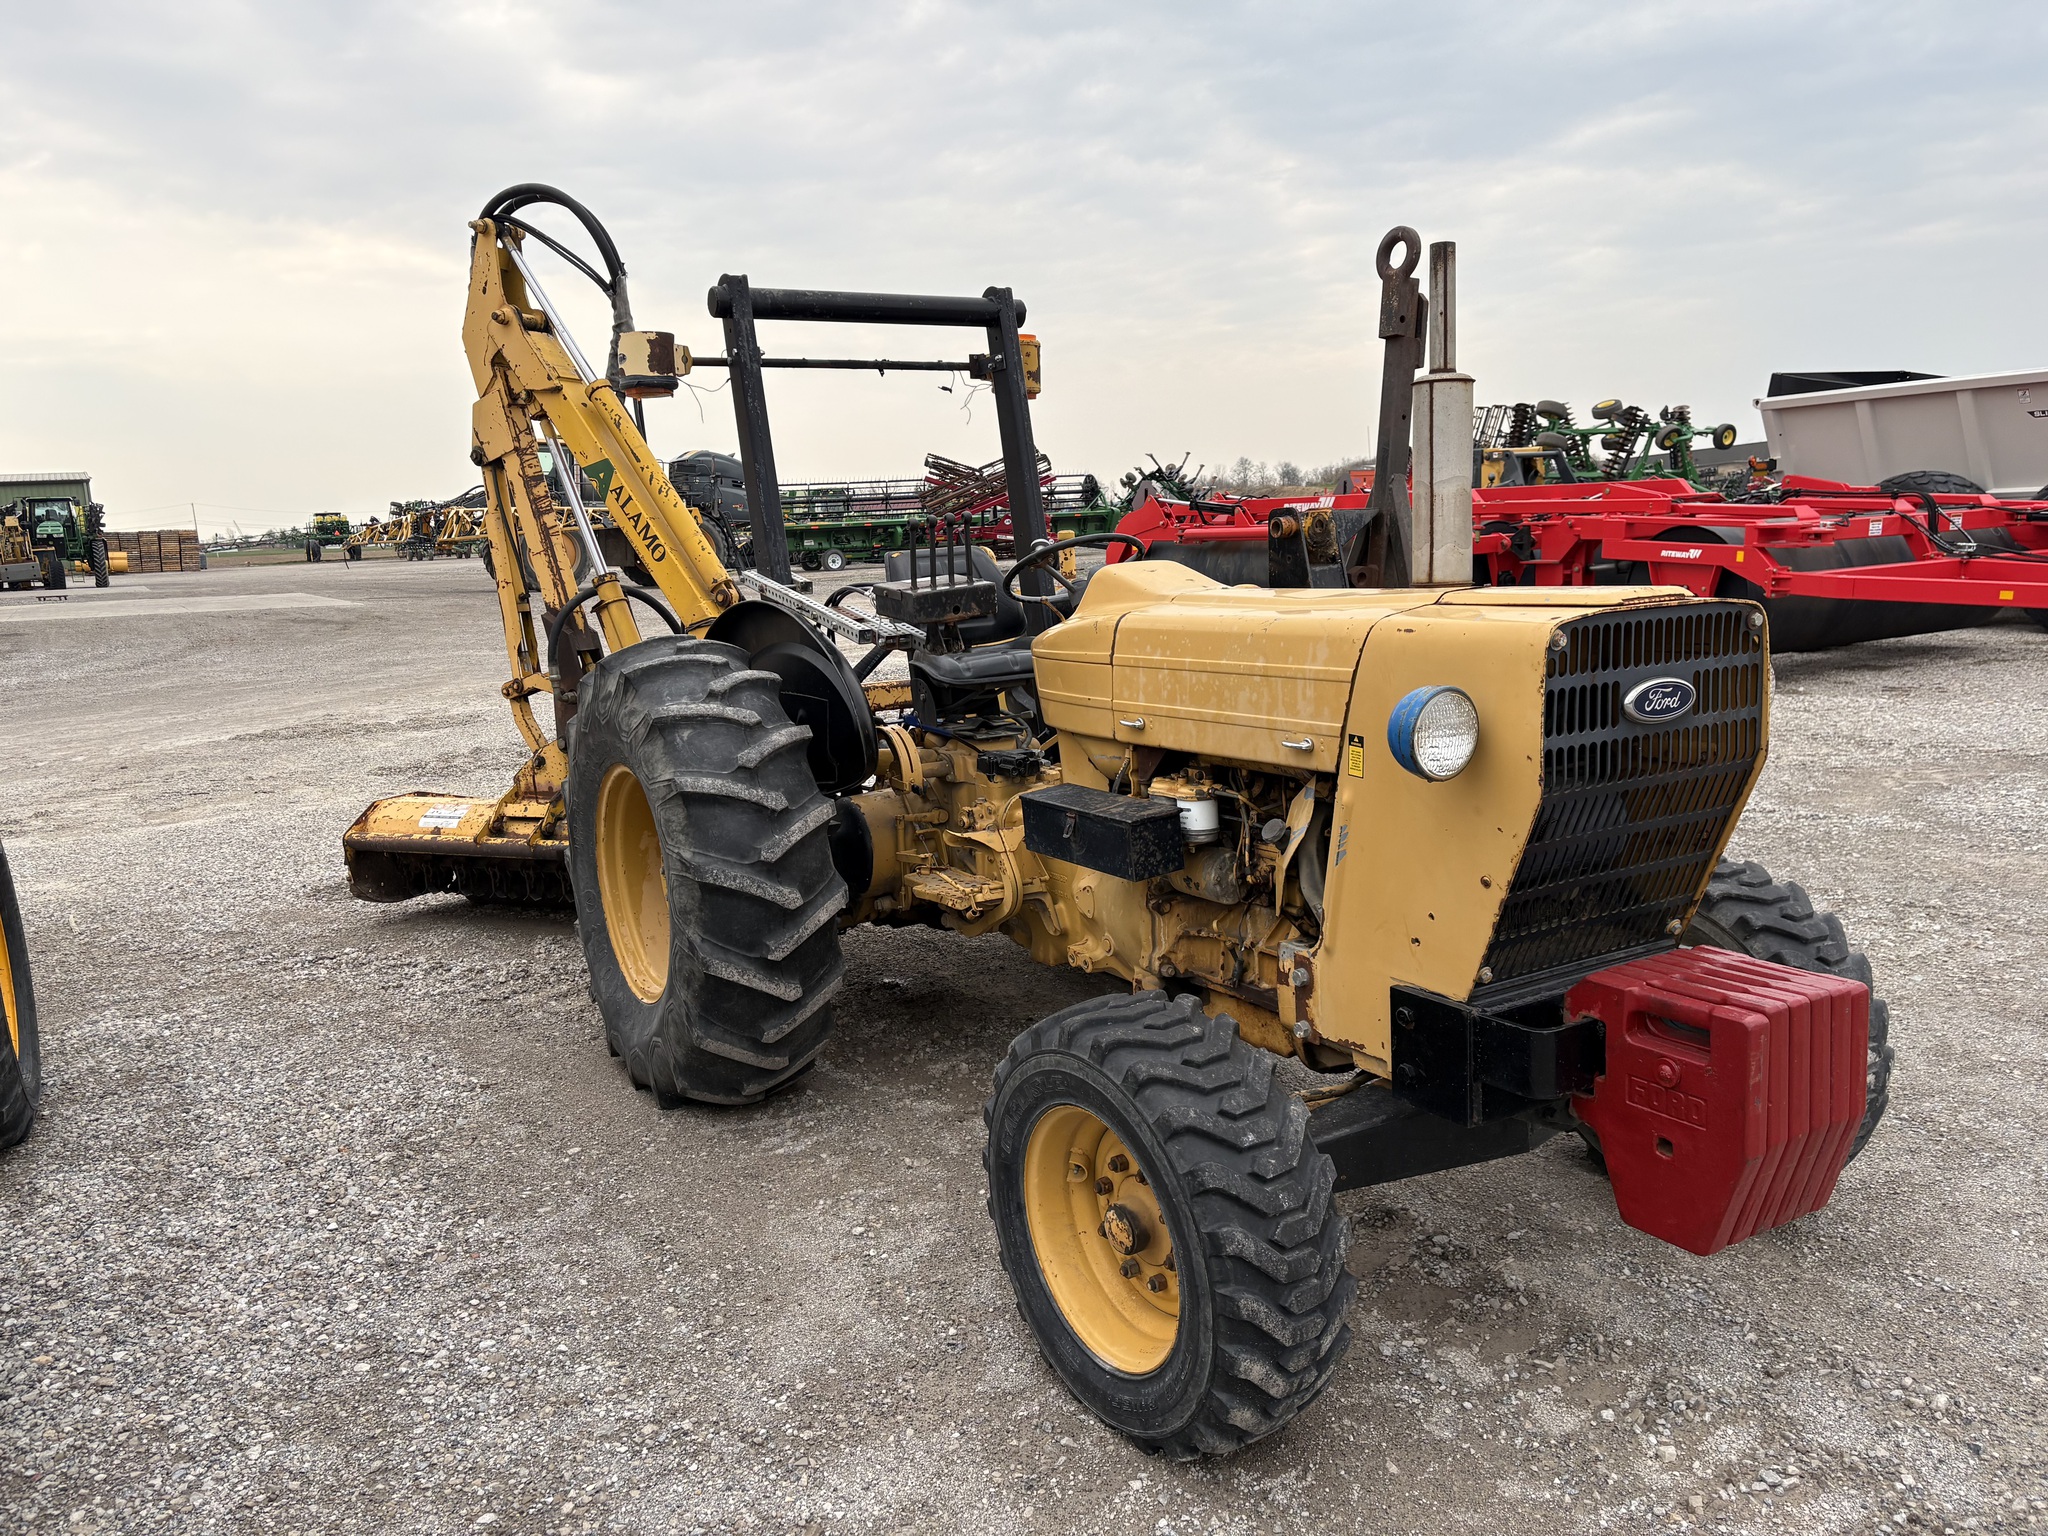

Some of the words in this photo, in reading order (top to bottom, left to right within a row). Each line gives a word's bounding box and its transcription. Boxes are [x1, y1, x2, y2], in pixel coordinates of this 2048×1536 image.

[609, 485, 667, 562] ALAMO
[1645, 687, 1681, 711] Ford
[1630, 1075, 1706, 1127] FORD
